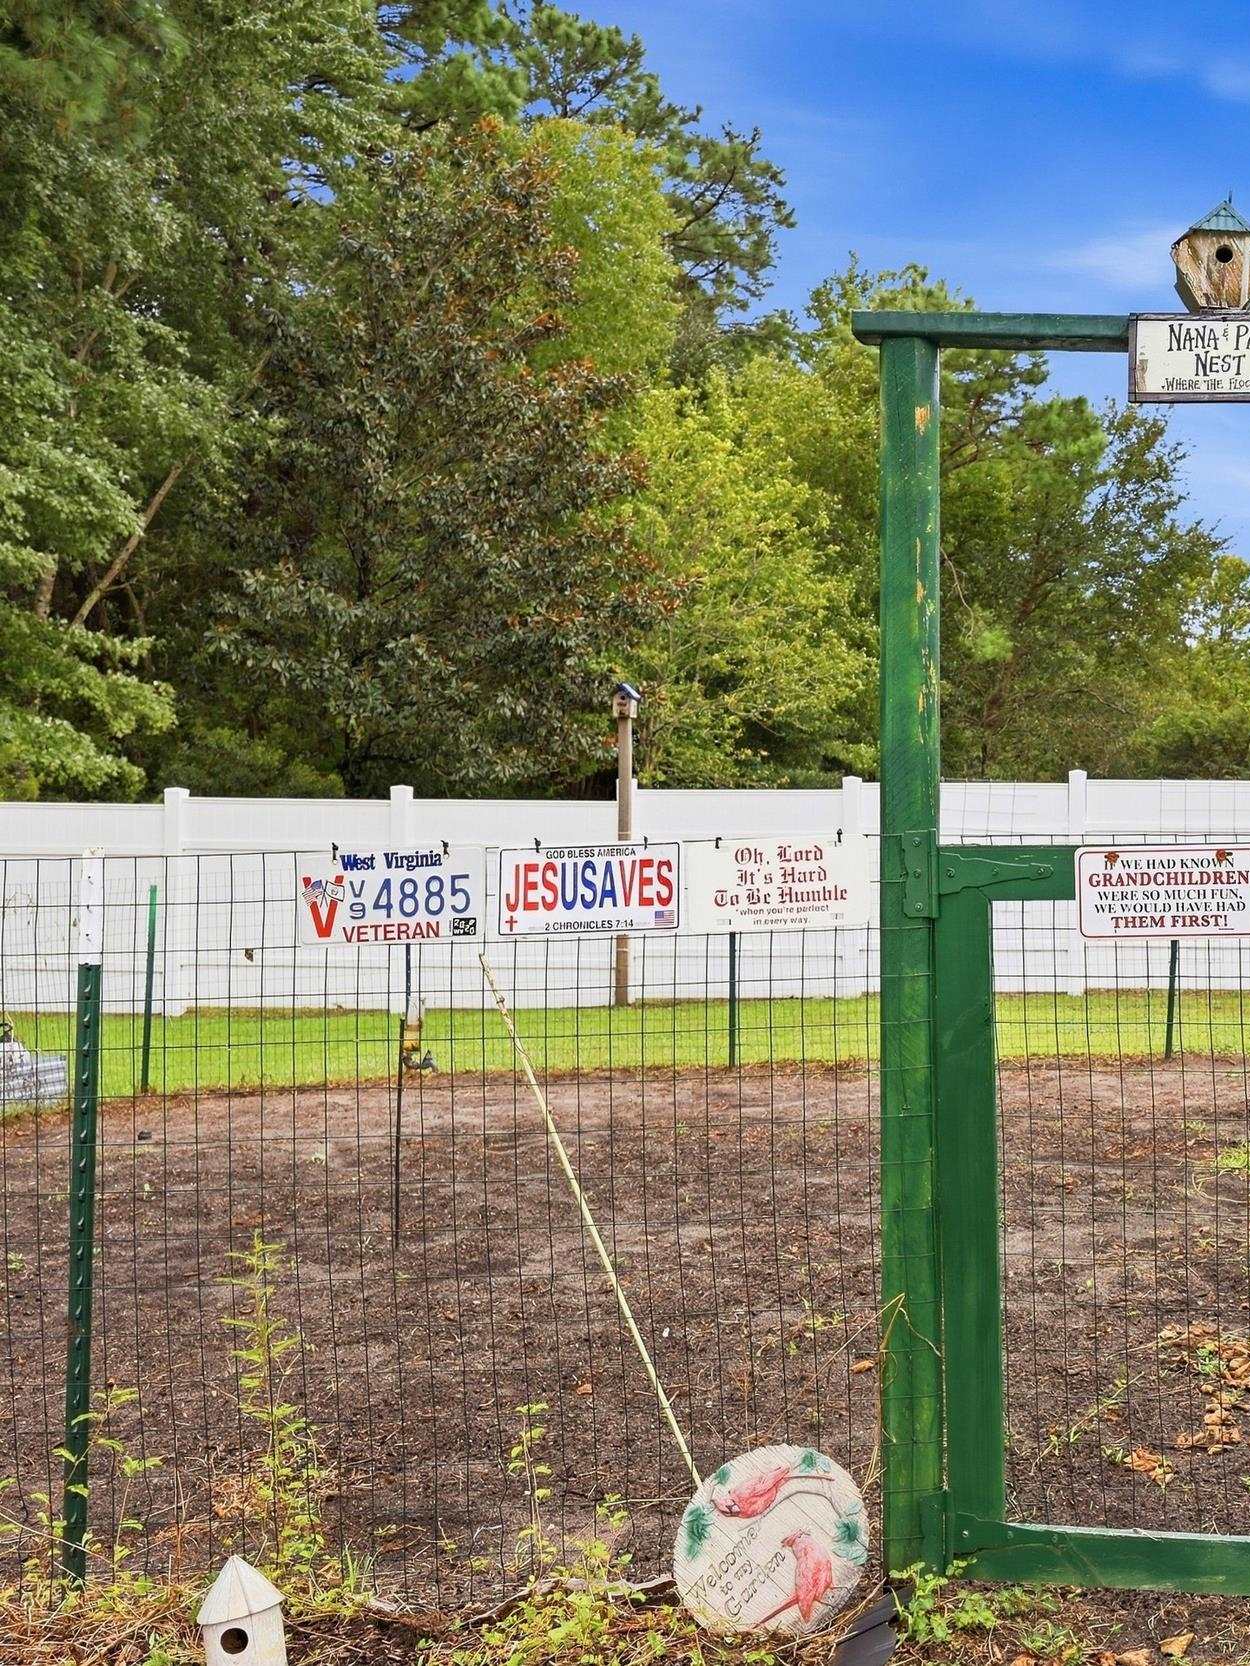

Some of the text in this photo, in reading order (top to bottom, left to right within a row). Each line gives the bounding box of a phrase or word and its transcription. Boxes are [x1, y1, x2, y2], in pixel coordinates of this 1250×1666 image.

[1167, 323, 1219, 351] NANA
[1195, 351, 1246, 376] NEST
[1165, 377, 1200, 391] WHERE
[1204, 378, 1223, 390] THE
[340, 850, 442, 871] West Virginia
[546, 848, 636, 859] GOD BLESS AMERICA
[777, 845, 824, 863] Lord
[1121, 859, 1142, 870] WE
[1147, 859, 1176, 869] HAD
[1180, 858, 1234, 869] KNOWN
[736, 866, 827, 887] It's Hard
[1088, 870, 1250, 887] GRANDCHILDREN
[505, 859, 674, 912] JESUSAVES
[373, 874, 471, 918] 4885
[714, 885, 848, 907] To Be Humble
[1098, 890, 1139, 901] WERE
[1142, 890, 1160, 900] SO
[1164, 889, 1206, 900] MUCH
[767, 906, 794, 915] you're
[1095, 901, 1246, 914] WE WOULD HAVE HAD
[545, 919, 634, 931] 2 CHRONICLES 7:14
[764, 918, 788, 926] every
[1111, 914, 1228, 929] THEM FIRST!
[342, 921, 440, 943] VETERAN
[686, 1527, 758, 1604] Welcome
[734, 1560, 753, 1580] my
[720, 1581, 733, 1596] to
